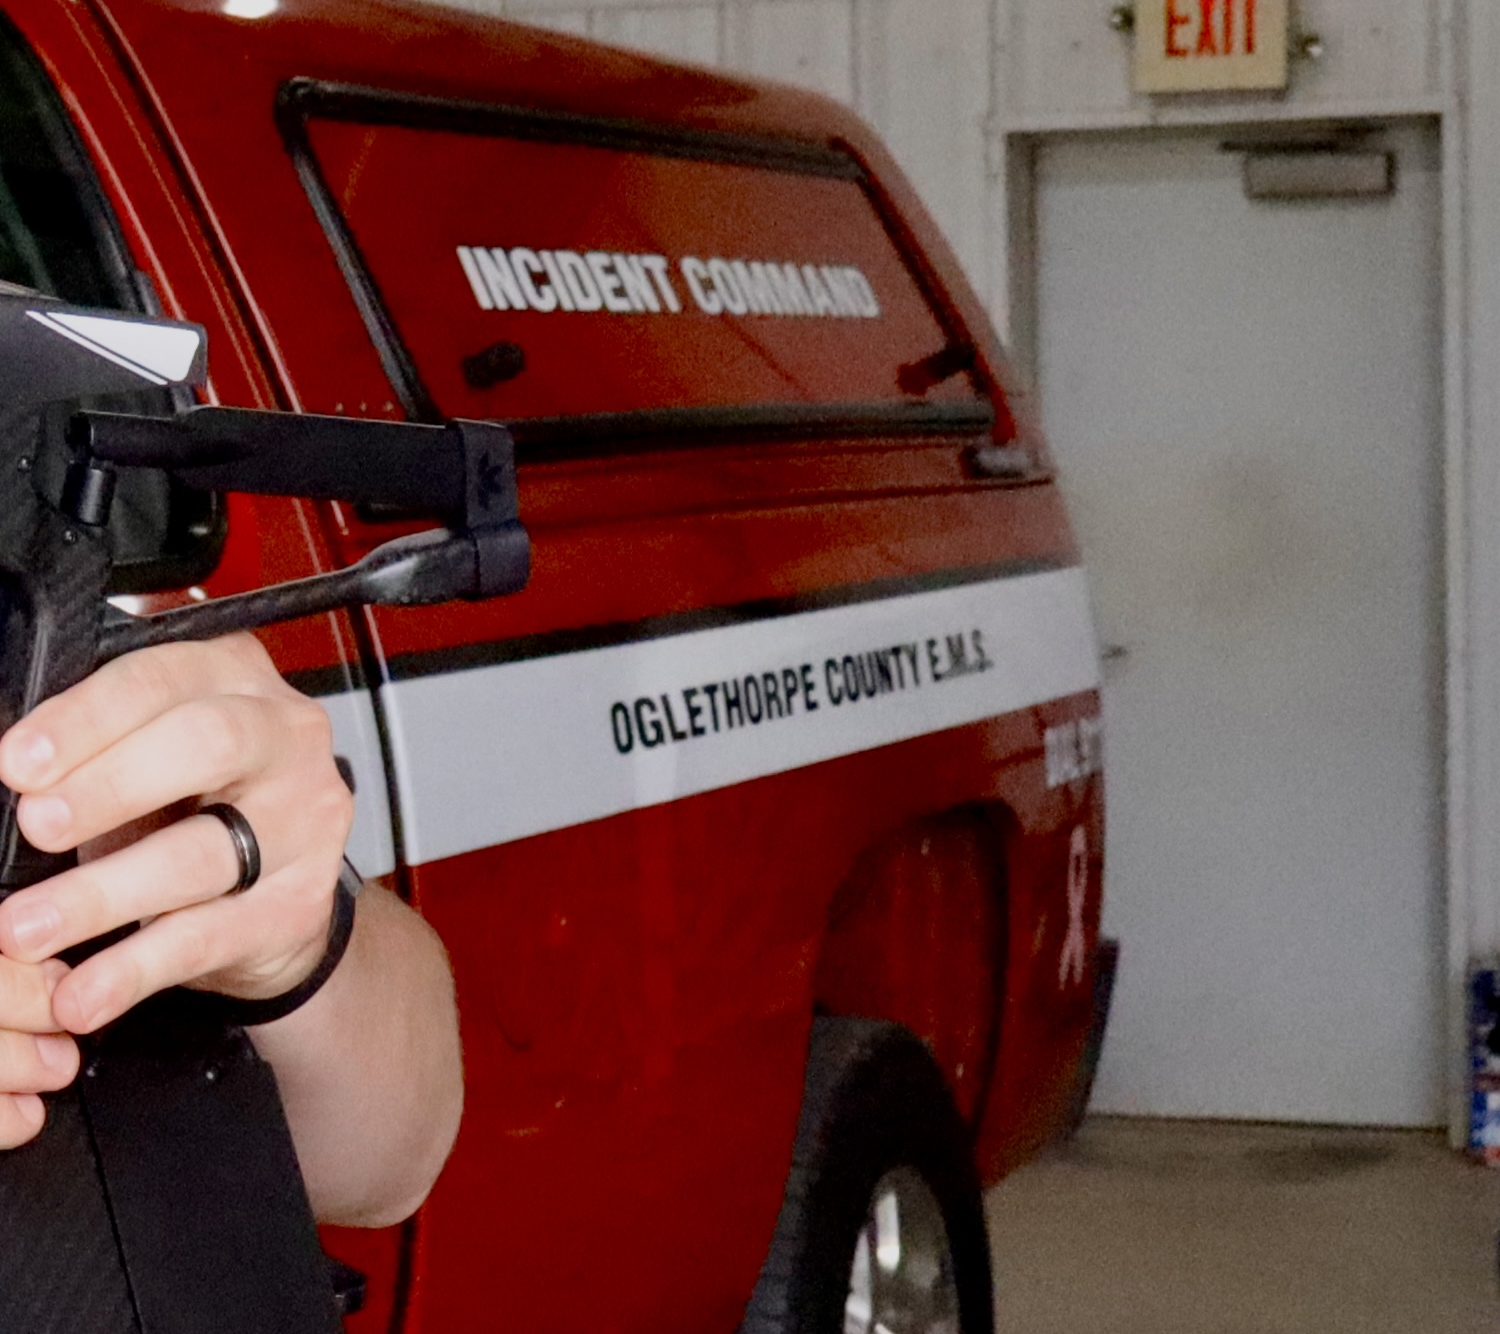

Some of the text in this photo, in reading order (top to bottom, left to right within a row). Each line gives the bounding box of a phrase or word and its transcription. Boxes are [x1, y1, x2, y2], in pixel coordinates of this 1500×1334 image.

[456, 245, 879, 318] INCIDENT COMMAND
[610, 628, 994, 755] OGLETHORPE COUNTY E.M.S.
